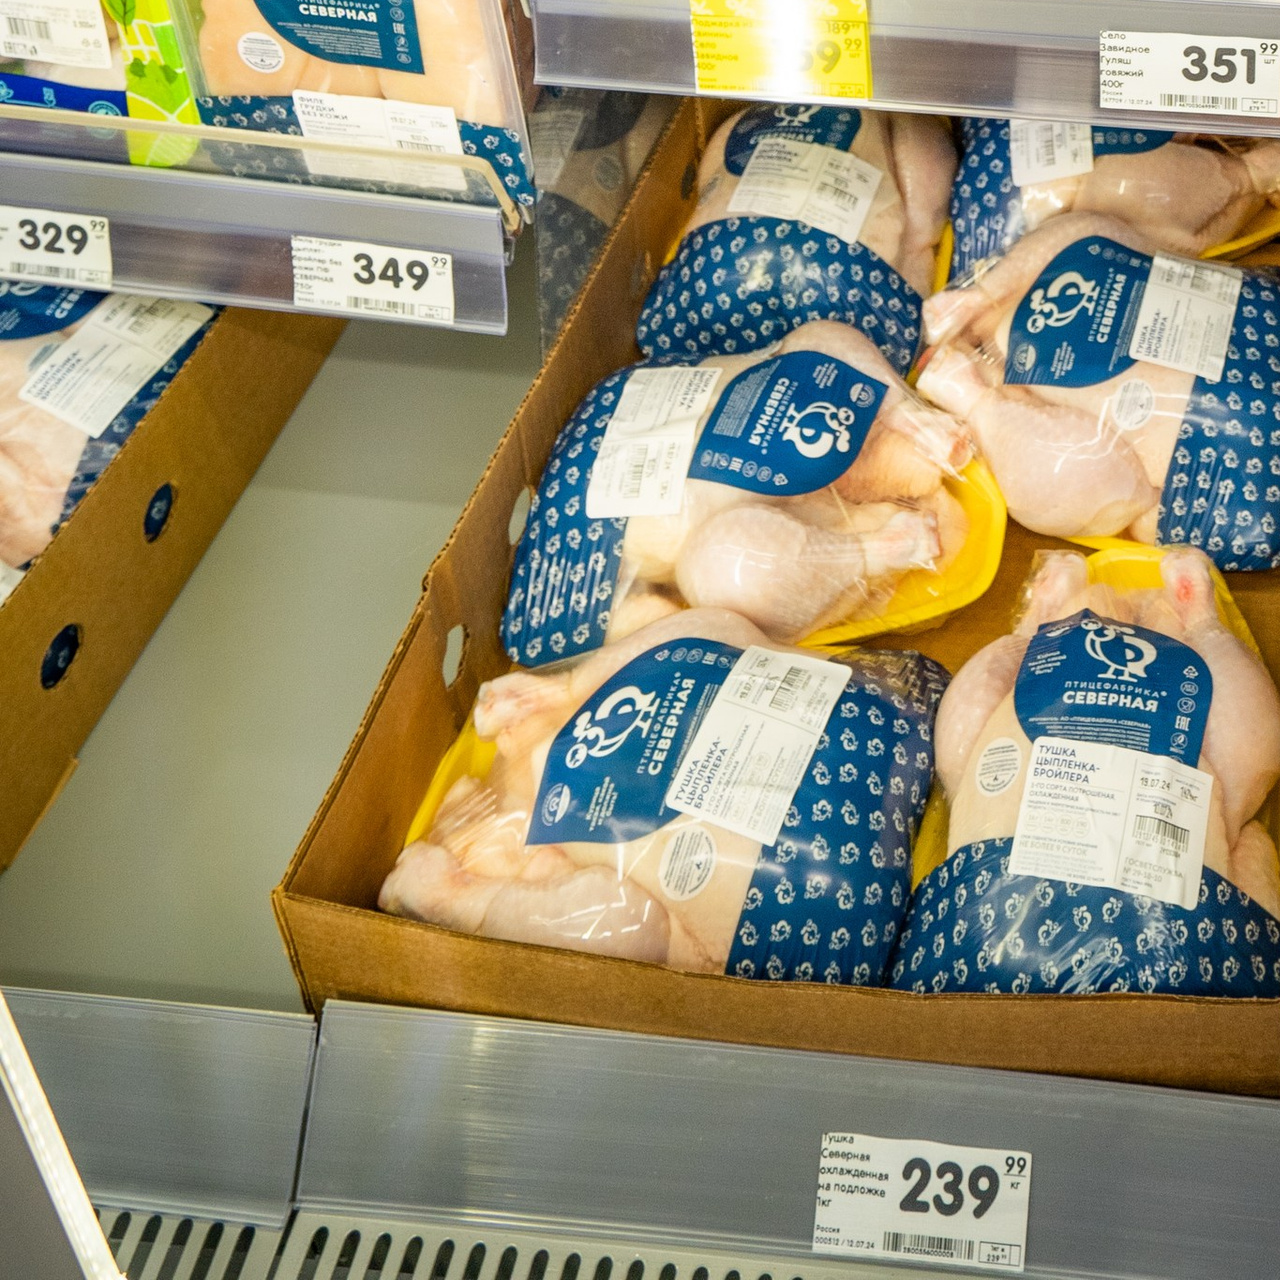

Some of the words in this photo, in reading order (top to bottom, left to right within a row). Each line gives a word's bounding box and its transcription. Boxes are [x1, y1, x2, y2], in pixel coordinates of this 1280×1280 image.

[299, 4, 377, 23] СЕВЕРНАЯ
[1100, 31, 1126, 40] Село
[1100, 44, 1150, 54] Завидное
[1101, 56, 1132, 65] Гуляш
[1182, 45, 1256, 84] 351
[1260, 42, 1279, 54] 99
[1100, 68, 1144, 77] говяжий
[18, 219, 88, 256] 329
[90, 220, 105, 232] 99
[353, 253, 429, 291] 349
[432, 256, 448, 267] 99
[1096, 273, 1128, 343] СЕВЕРНАЯ
[748, 377, 790, 447] СЕВЕРНАЯ
[1062, 691, 1158, 713] СЕВЕРНАЯ
[648, 678, 696, 776] СЕВЕРНАЯ
[1039, 744, 1077, 758] ТУШКА
[1036, 756, 1100, 773] ЦЫПЛЕНКА-
[674, 759, 701, 801] ТУШКА
[694, 747, 728, 810] БРОЙЛЕРА
[1033, 767, 1090, 785] БРОЙЛЕРА
[821, 1148, 870, 1162] Северная
[820, 1167, 889, 1182] охлажденная
[818, 1183, 831, 1191] на
[834, 1183, 886, 1198] подложке
[899, 1157, 999, 1219] 239
[1005, 1156, 1026, 1174] 99
[1010, 1181, 1020, 1190] кг
[817, 1198, 832, 1208] 1кг
